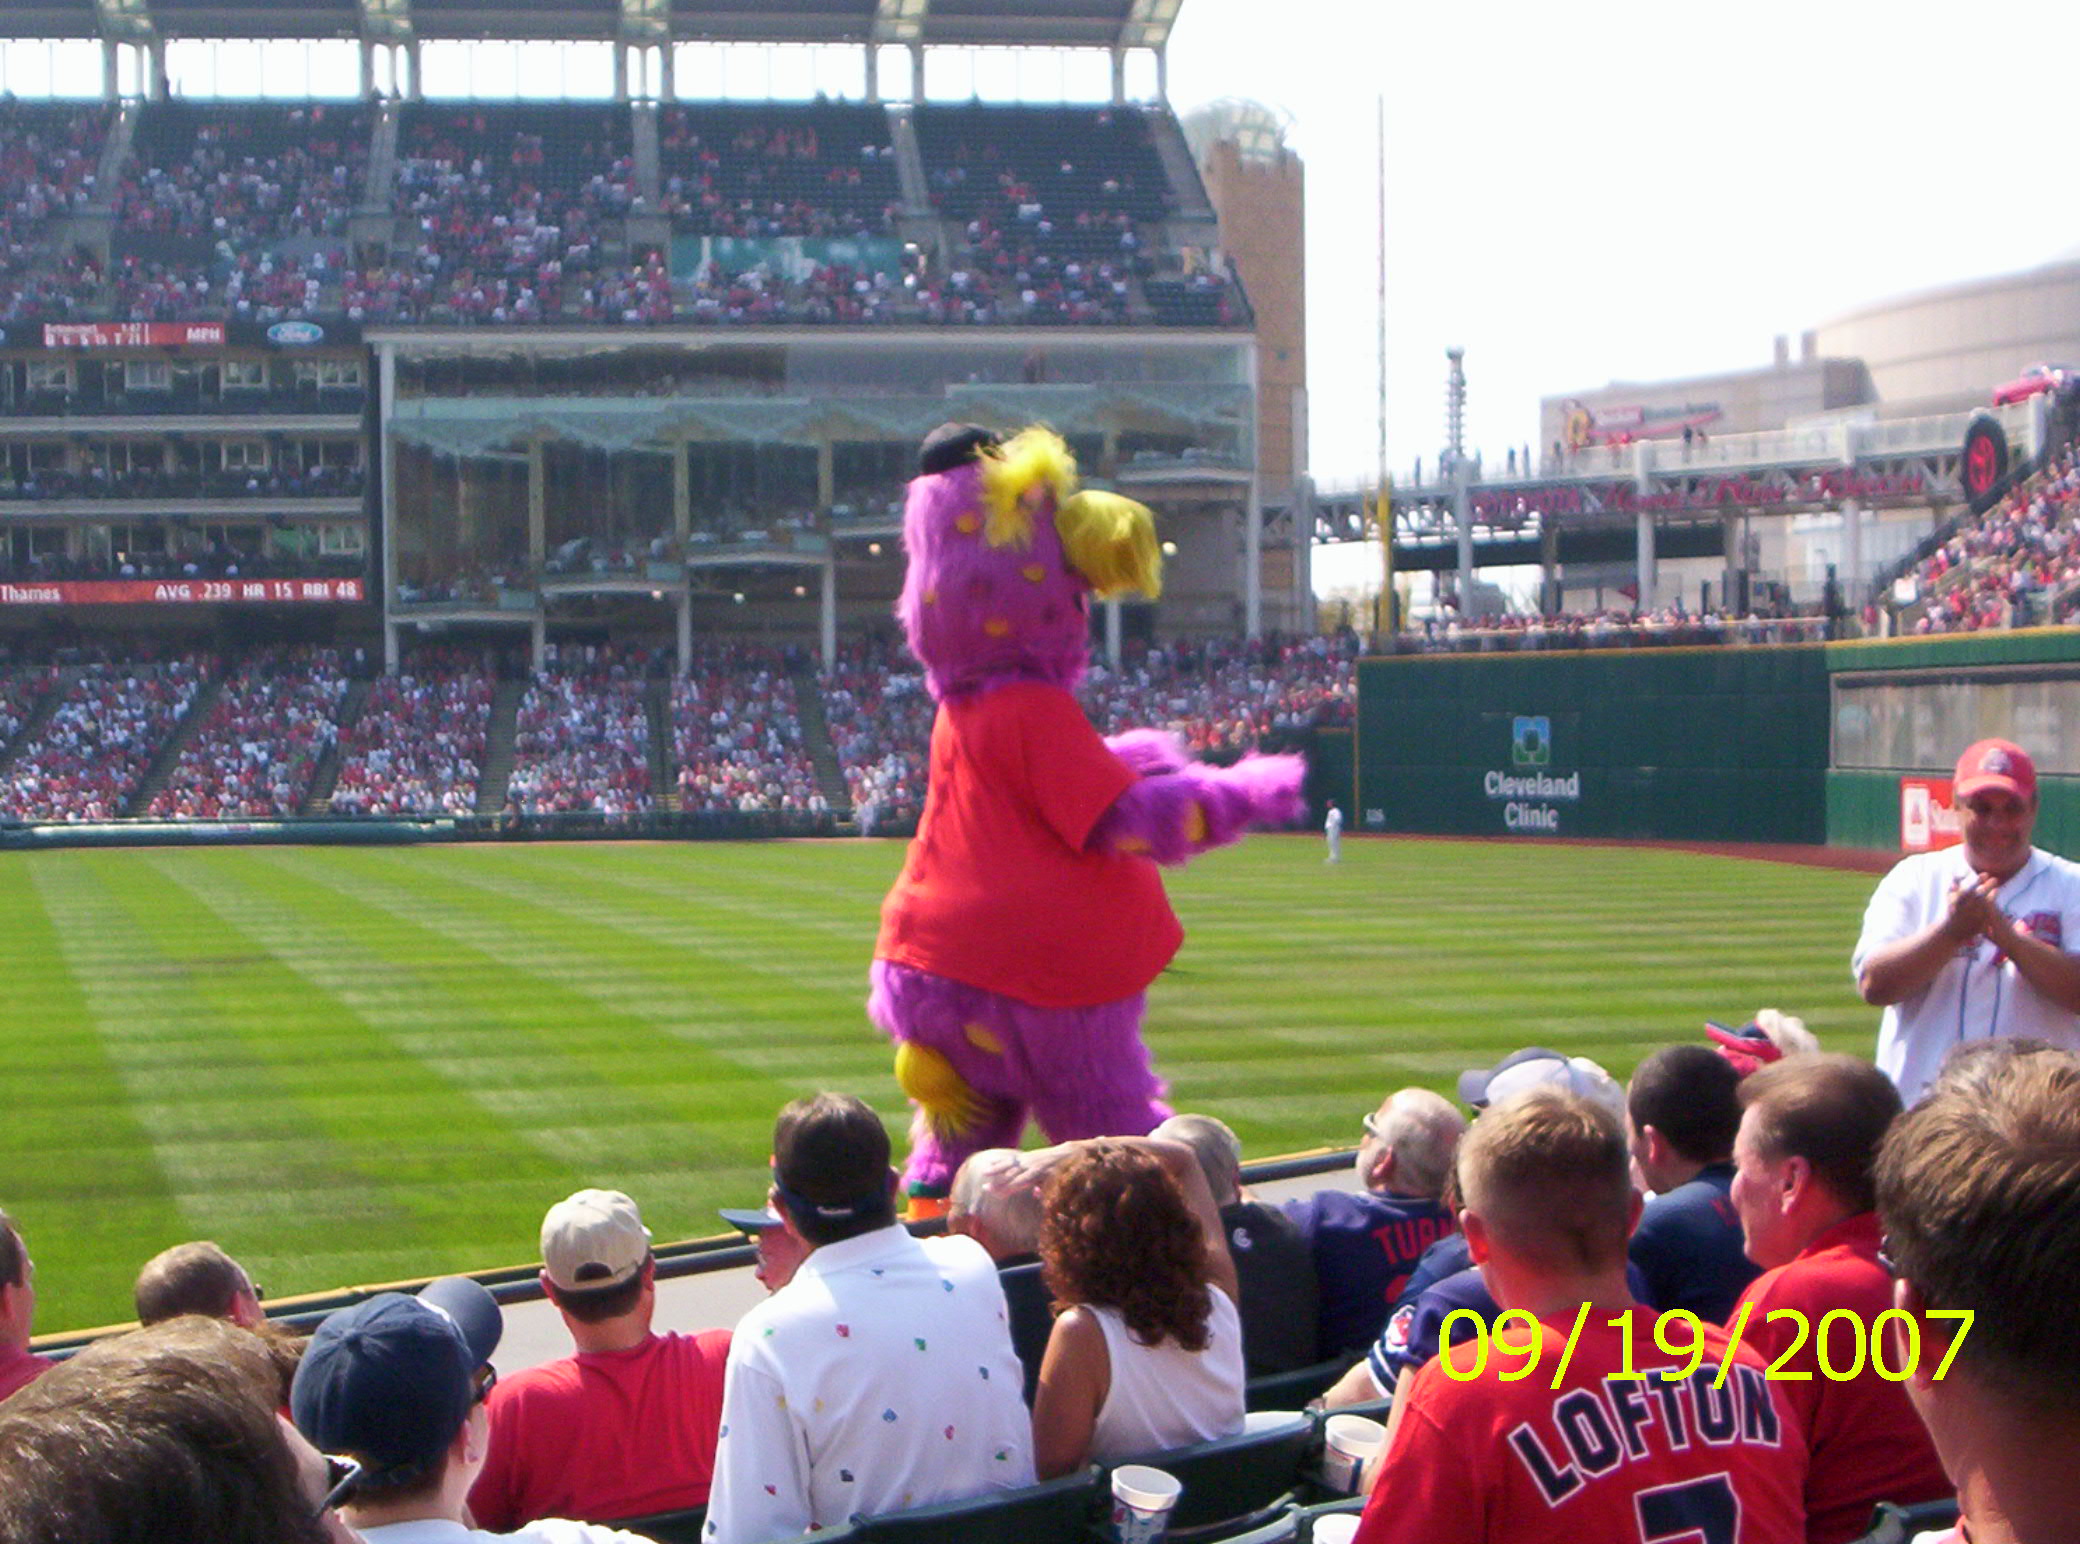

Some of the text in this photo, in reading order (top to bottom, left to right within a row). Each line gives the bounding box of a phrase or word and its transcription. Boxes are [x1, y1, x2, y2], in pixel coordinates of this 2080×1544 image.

[186, 328, 220, 341] MPH
[0, 580, 356, 601] Thames AVG .239 HR 15 RBI 48
[1484, 770, 1580, 797] Cleveland
[1504, 802, 1559, 829] Clinic
[1507, 1363, 1783, 1507] LOFTON
